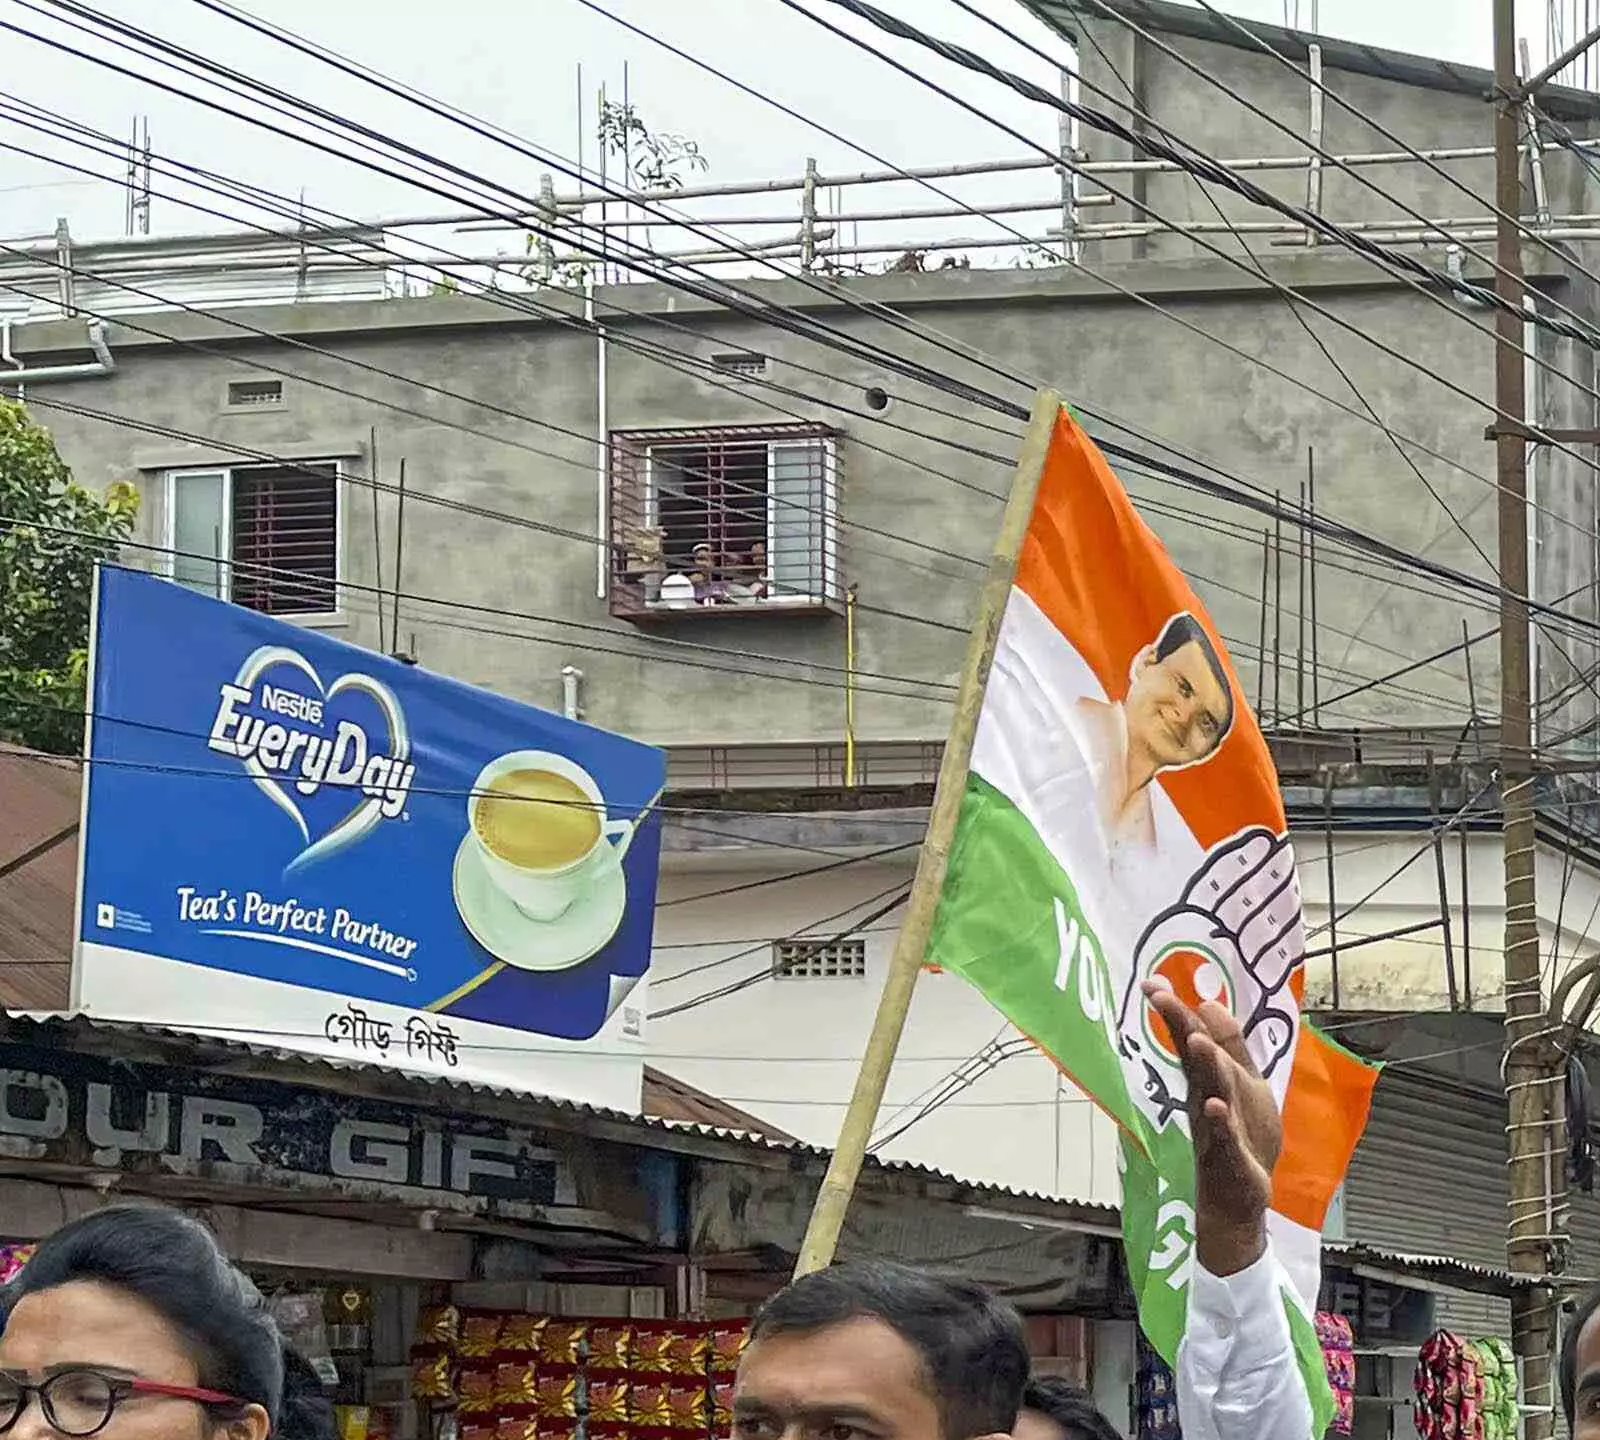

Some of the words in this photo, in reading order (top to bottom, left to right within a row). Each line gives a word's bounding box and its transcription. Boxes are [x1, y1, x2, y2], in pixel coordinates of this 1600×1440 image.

[177, 887, 236, 922] Tea's
[244, 891, 325, 933] Perfect
[332, 908, 417, 960] Partner
